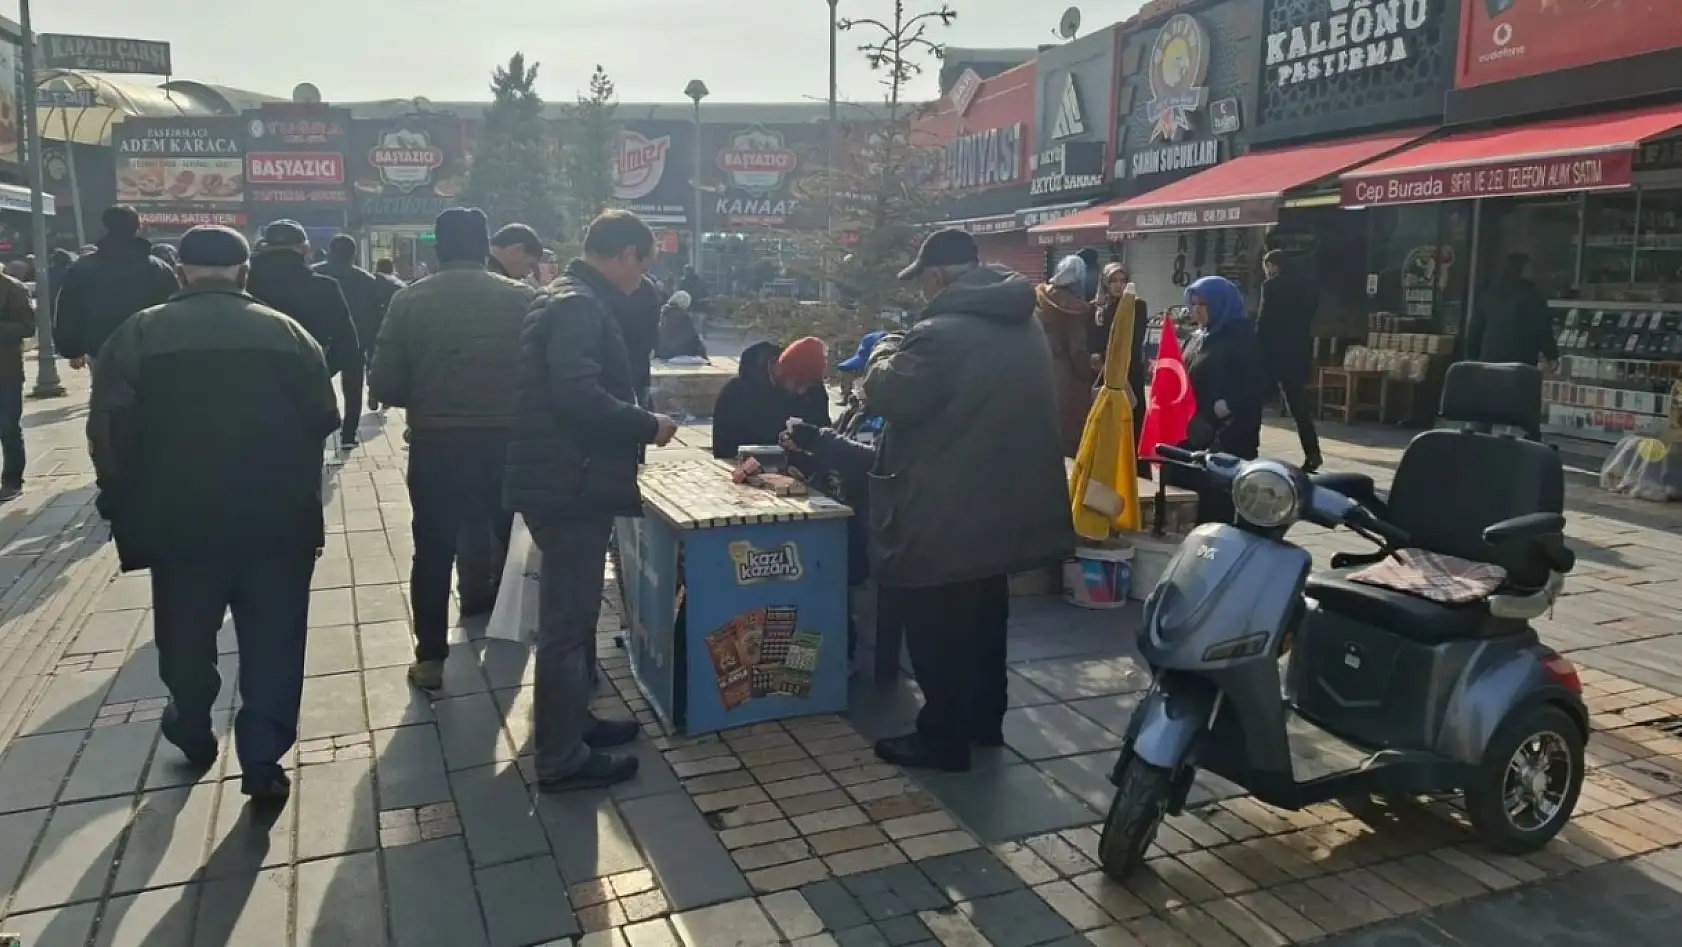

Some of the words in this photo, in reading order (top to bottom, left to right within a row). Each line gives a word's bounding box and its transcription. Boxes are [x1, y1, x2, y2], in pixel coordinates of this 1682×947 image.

[1278, 37, 1407, 87] PASTIRMA
[119, 138, 164, 153] ADEM
[169, 138, 239, 153] KARACA
[252, 159, 336, 180] BAŞYAZICI
[1355, 182, 1383, 202] Cep
[1388, 175, 1444, 198] Burada
[1507, 165, 1546, 189] TELEFON
[716, 198, 798, 215] KANAAT
